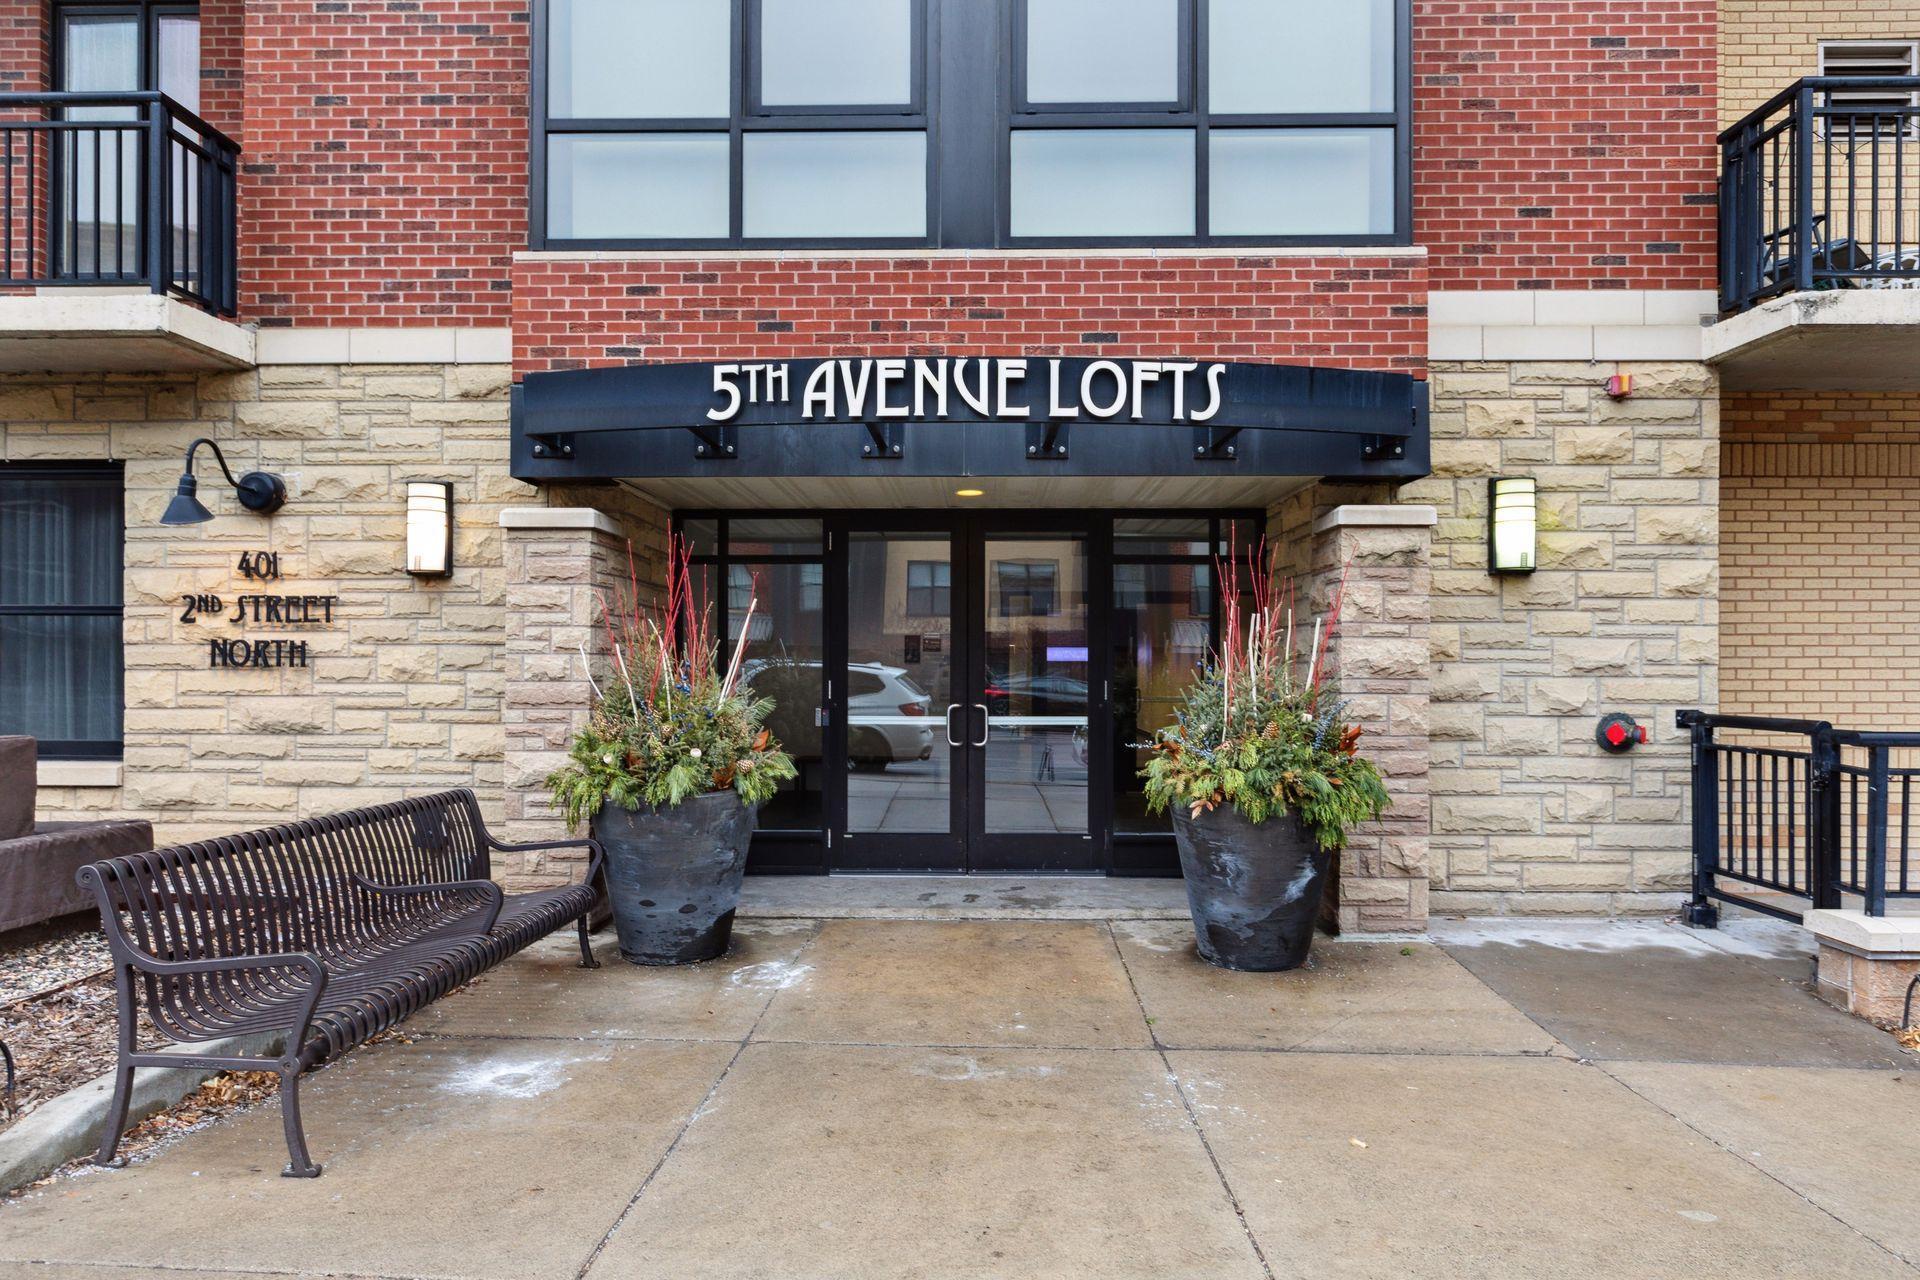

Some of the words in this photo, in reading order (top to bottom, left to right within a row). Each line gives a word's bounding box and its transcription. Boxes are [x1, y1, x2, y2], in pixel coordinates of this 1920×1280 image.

[706, 363, 790, 421] 5TH
[801, 358, 1031, 418] AVENUE
[1048, 359, 1226, 422] LOFTS
[237, 551, 278, 578] 401
[180, 594, 223, 623] 2ND
[229, 595, 337, 623] STREET
[210, 639, 307, 667] NORTH
